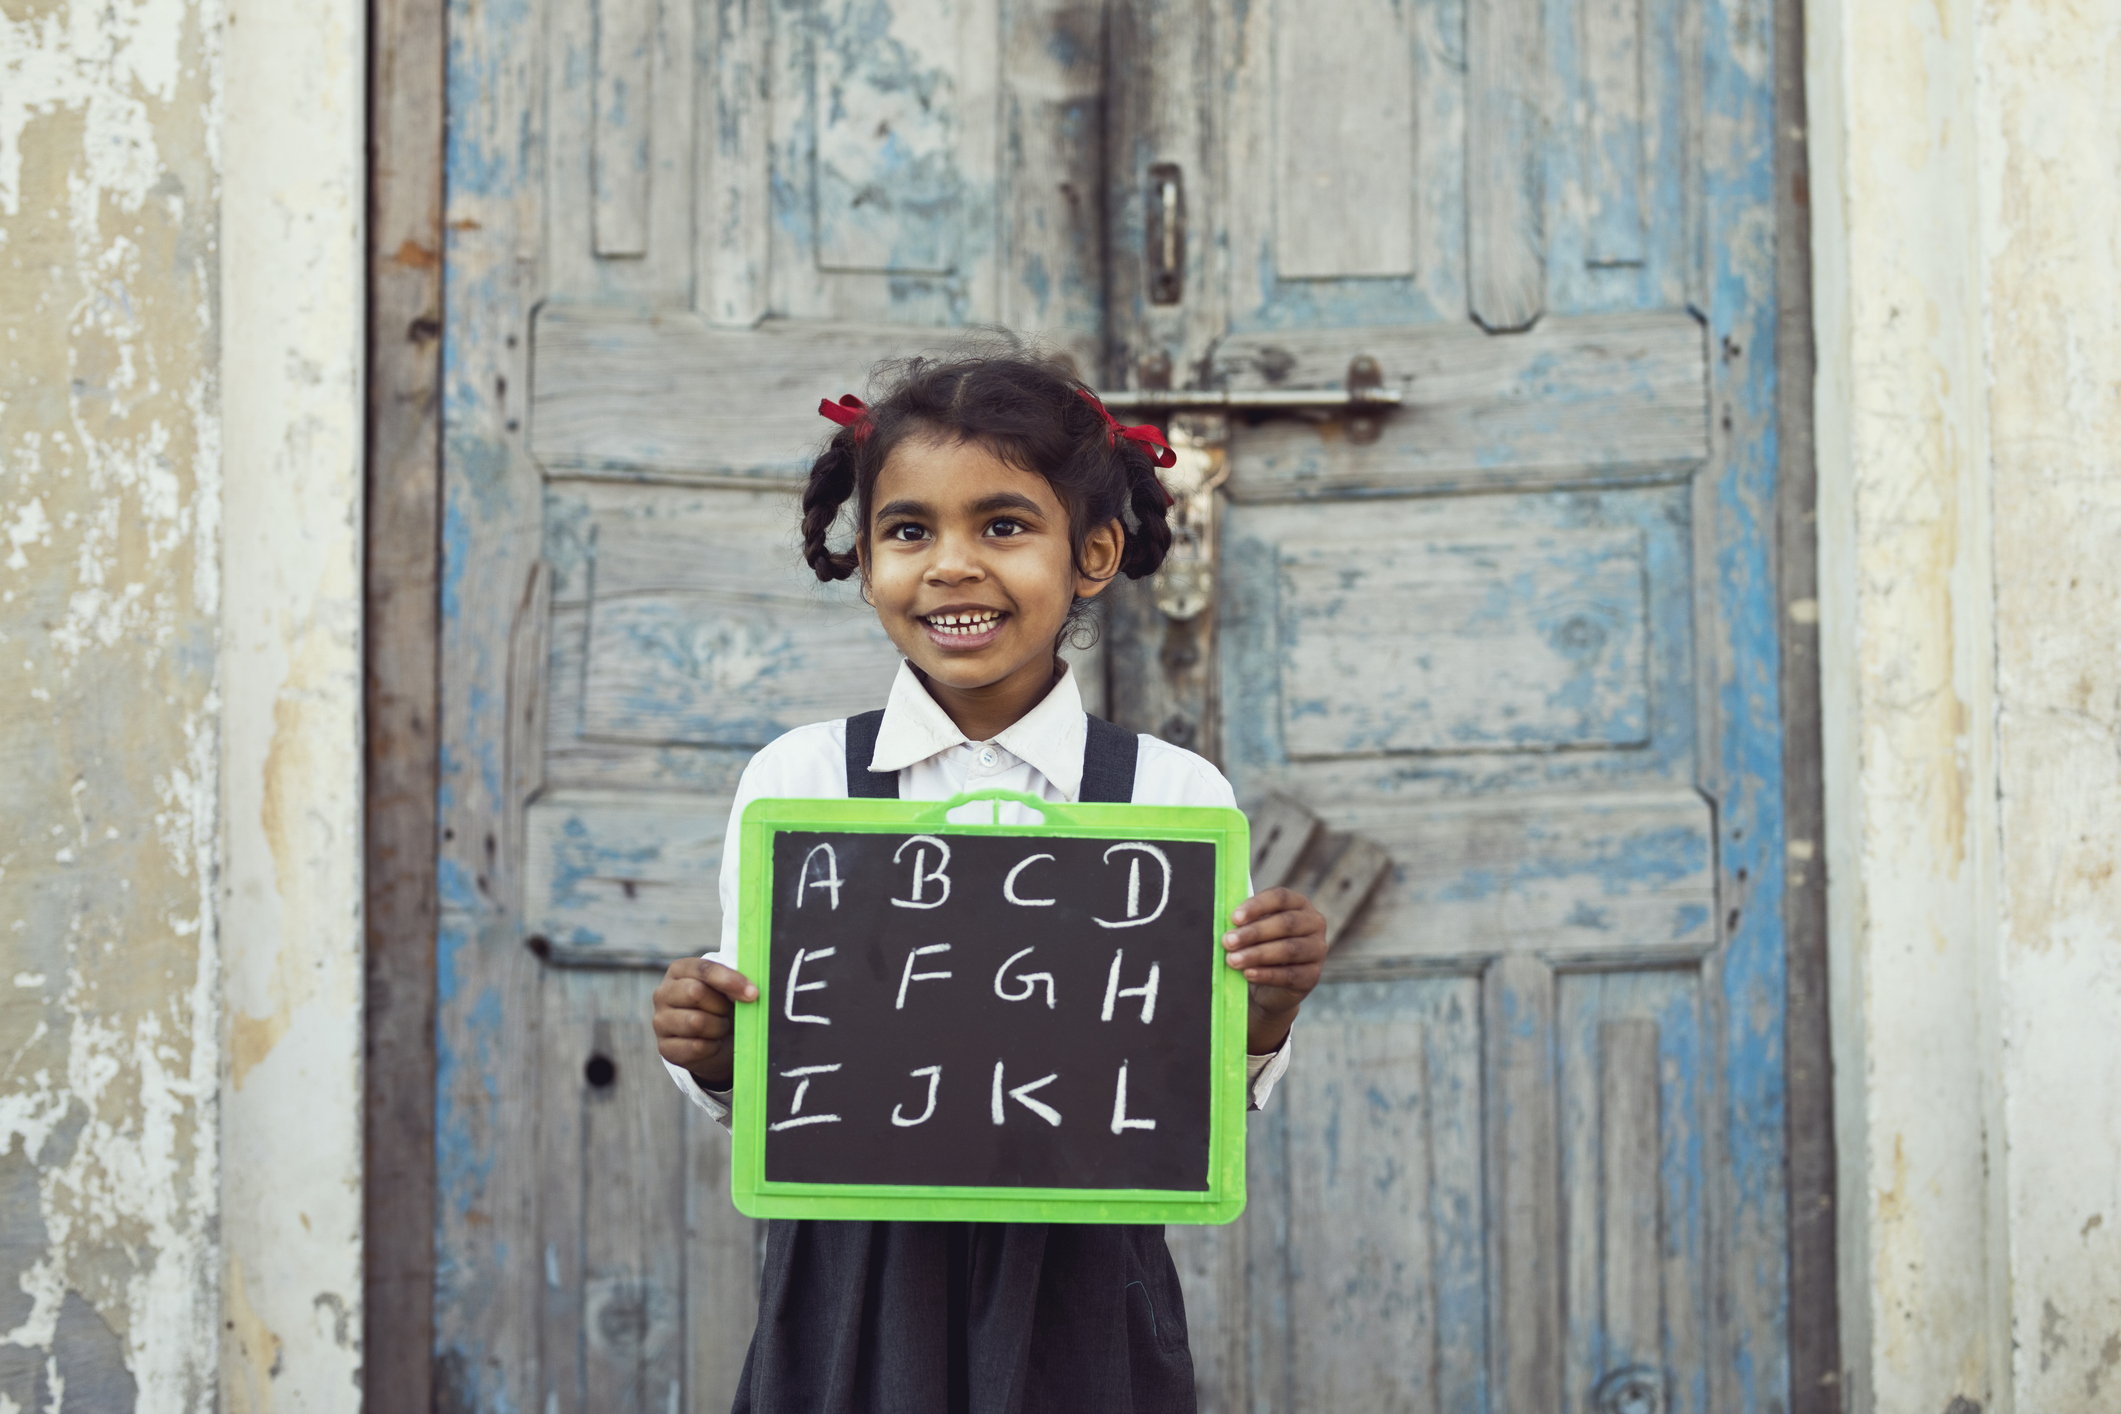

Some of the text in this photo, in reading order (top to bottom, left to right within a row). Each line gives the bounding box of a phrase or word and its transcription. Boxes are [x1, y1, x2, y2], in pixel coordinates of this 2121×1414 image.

[796, 835, 1172, 928] A B C D
[785, 943, 1160, 1025] E F G H
[769, 1059, 1156, 1135] I J K L
